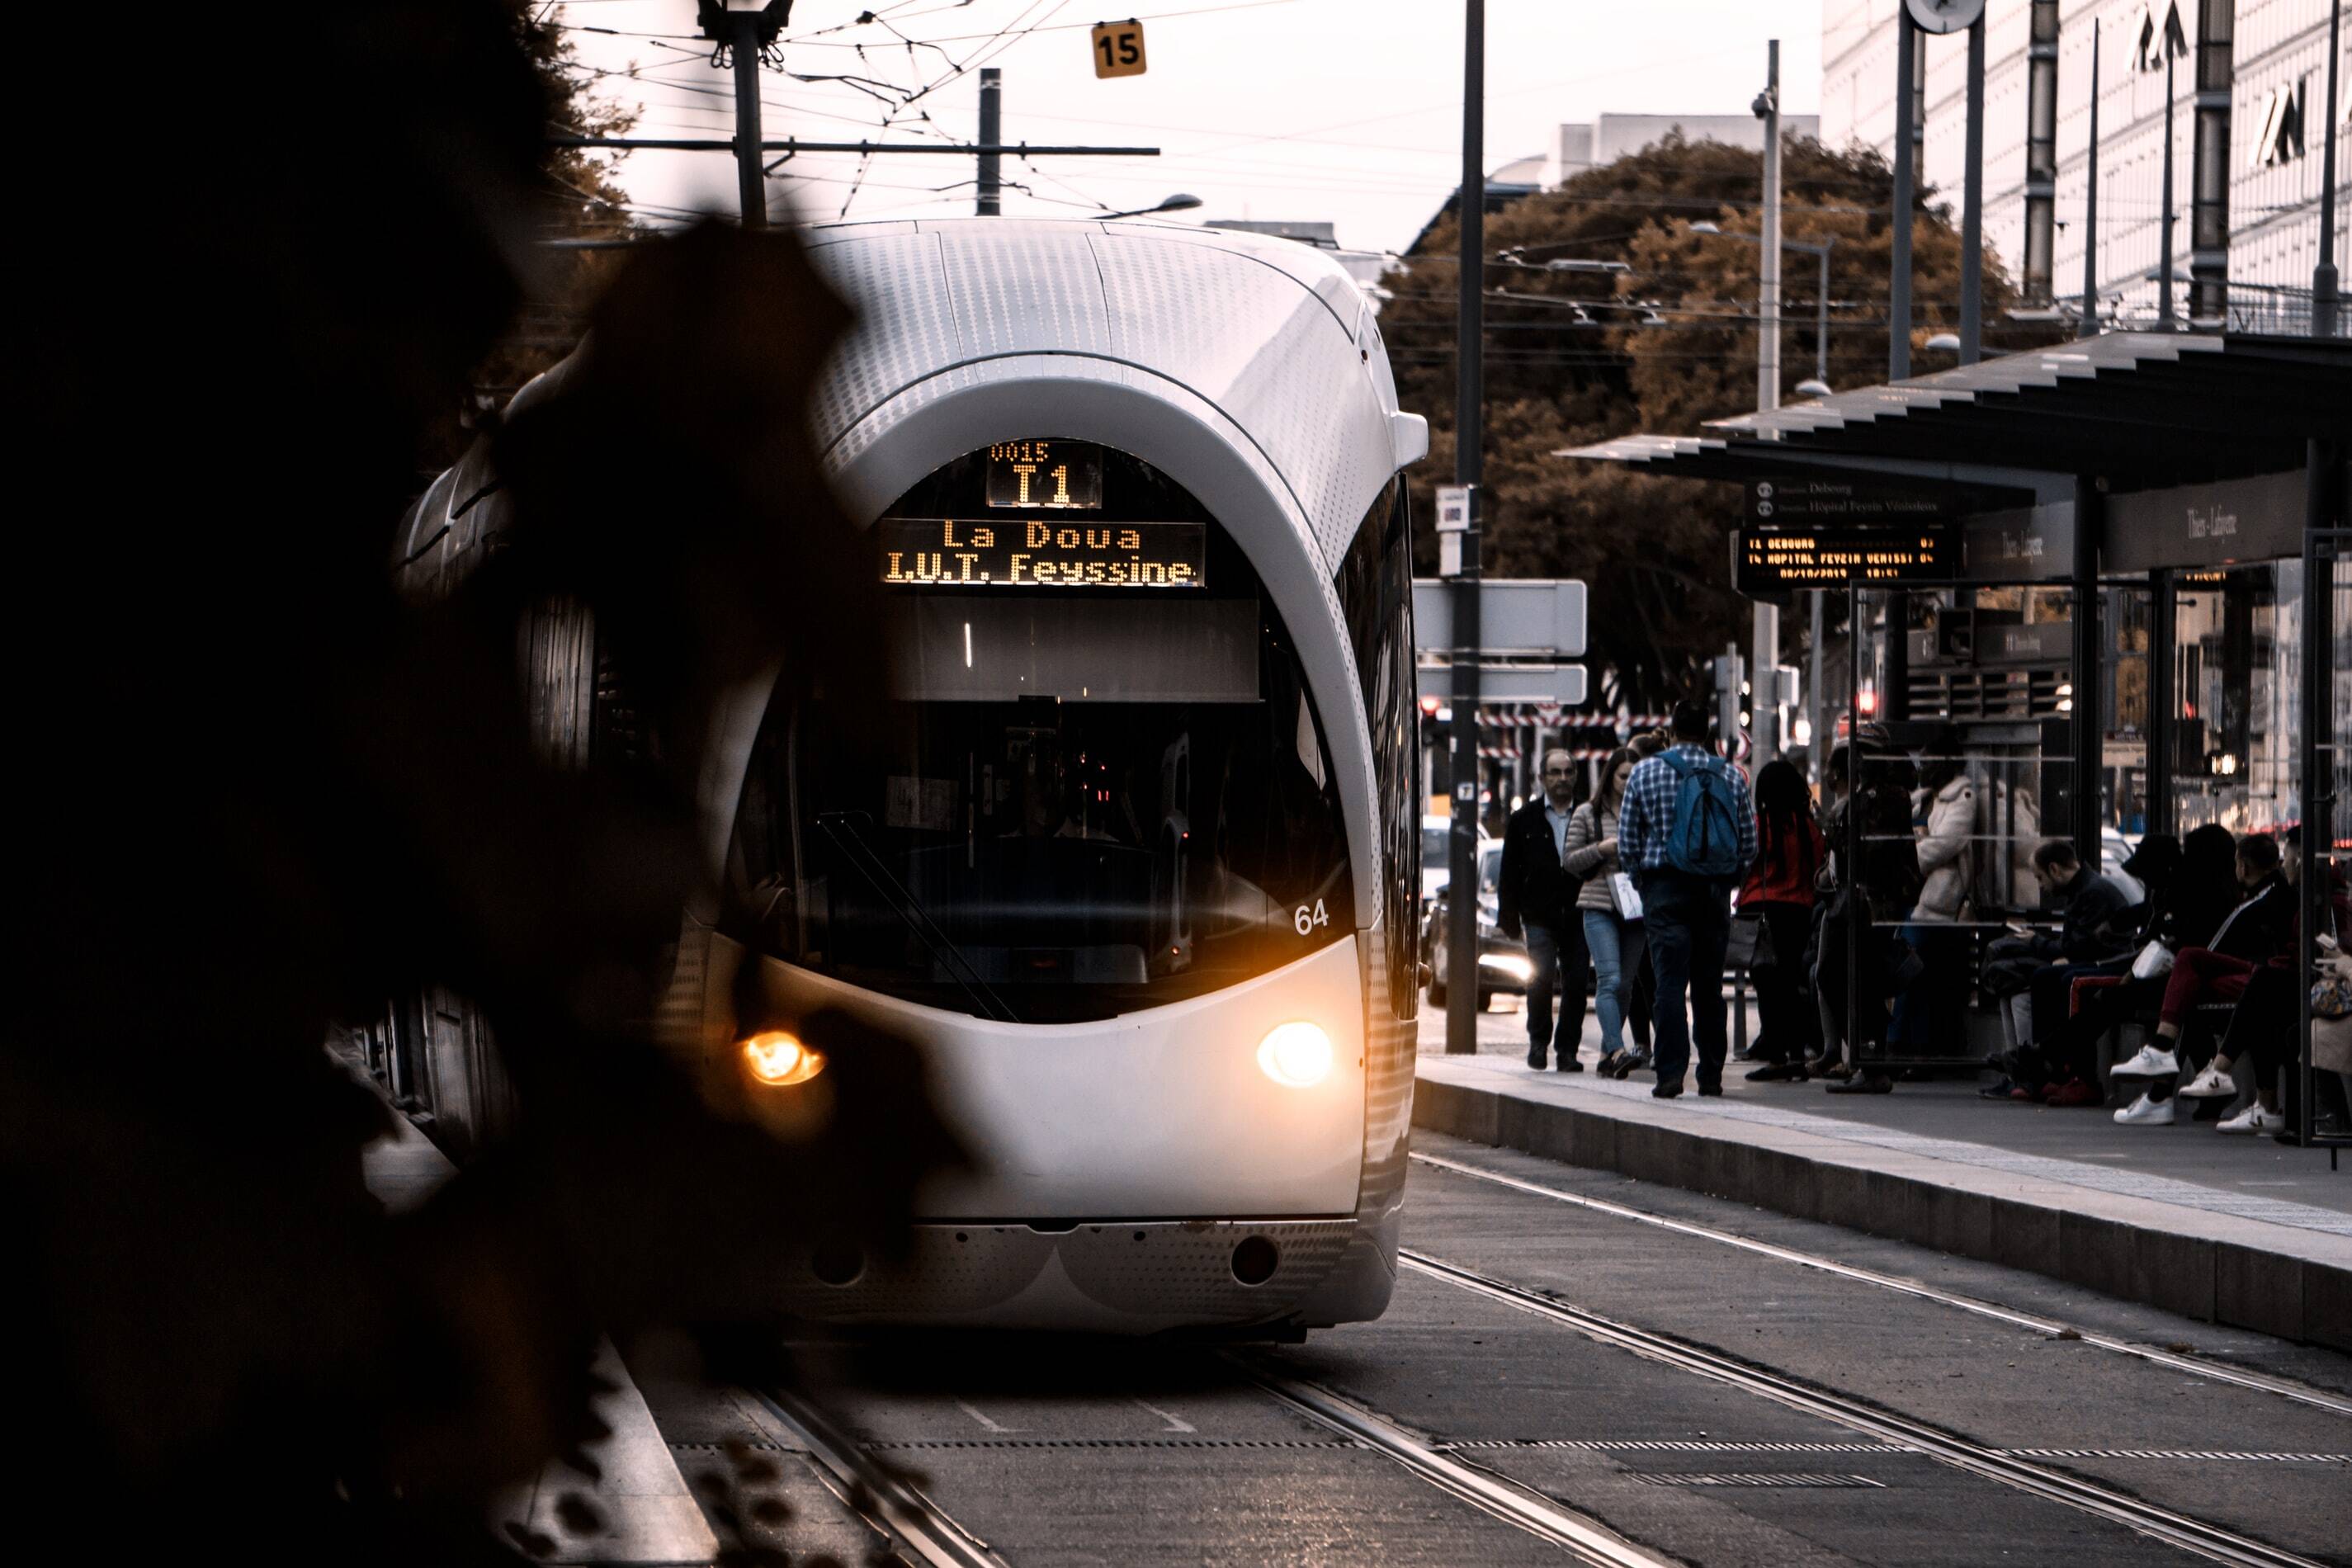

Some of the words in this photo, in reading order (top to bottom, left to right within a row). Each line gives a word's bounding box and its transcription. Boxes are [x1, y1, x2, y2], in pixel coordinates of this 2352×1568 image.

[1098, 33, 1140, 67] 15
[991, 442, 1049, 462] 0015
[1013, 465, 1070, 503] T1
[944, 519, 994, 547] La
[1027, 521, 1140, 549] Doua
[886, 552, 989, 581] I.U.T.
[1011, 554, 1192, 583] Feyssine
[1768, 553, 1815, 564] HOPITAL
[1820, 553, 1862, 564] FEYZIN
[1294, 897, 1329, 936] 64
